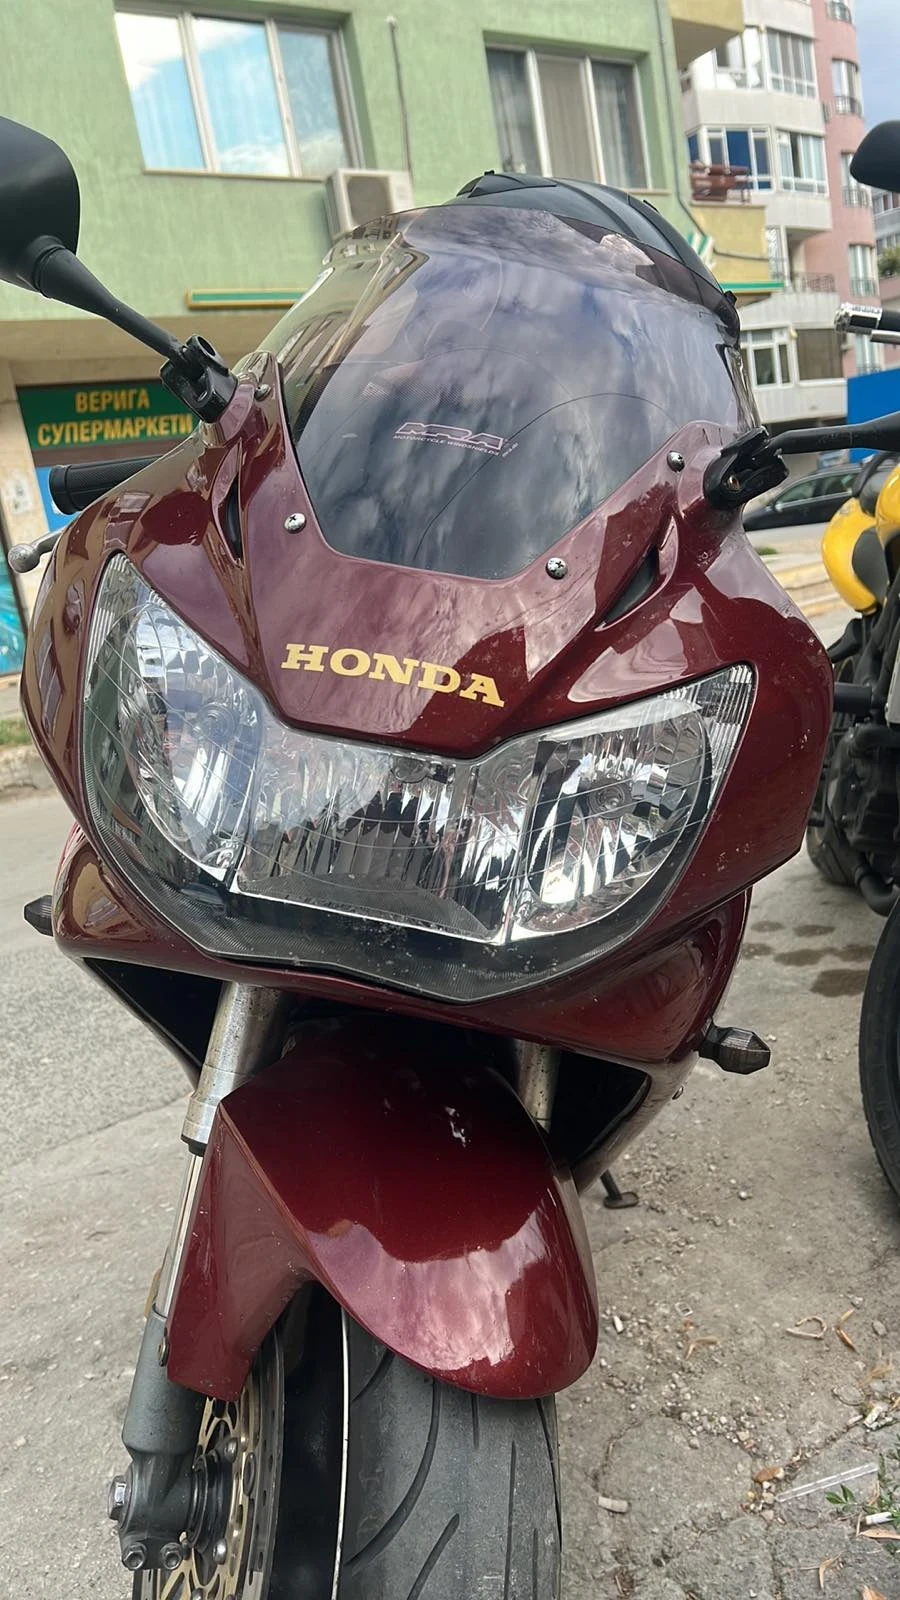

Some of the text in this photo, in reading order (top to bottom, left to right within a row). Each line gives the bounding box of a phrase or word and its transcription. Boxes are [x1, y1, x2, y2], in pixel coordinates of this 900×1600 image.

[76, 389, 149, 412] ВЕРИГА
[38, 414, 193, 445] СУПЕРМАРКЕТИ
[281, 644, 504, 707] HONDA
